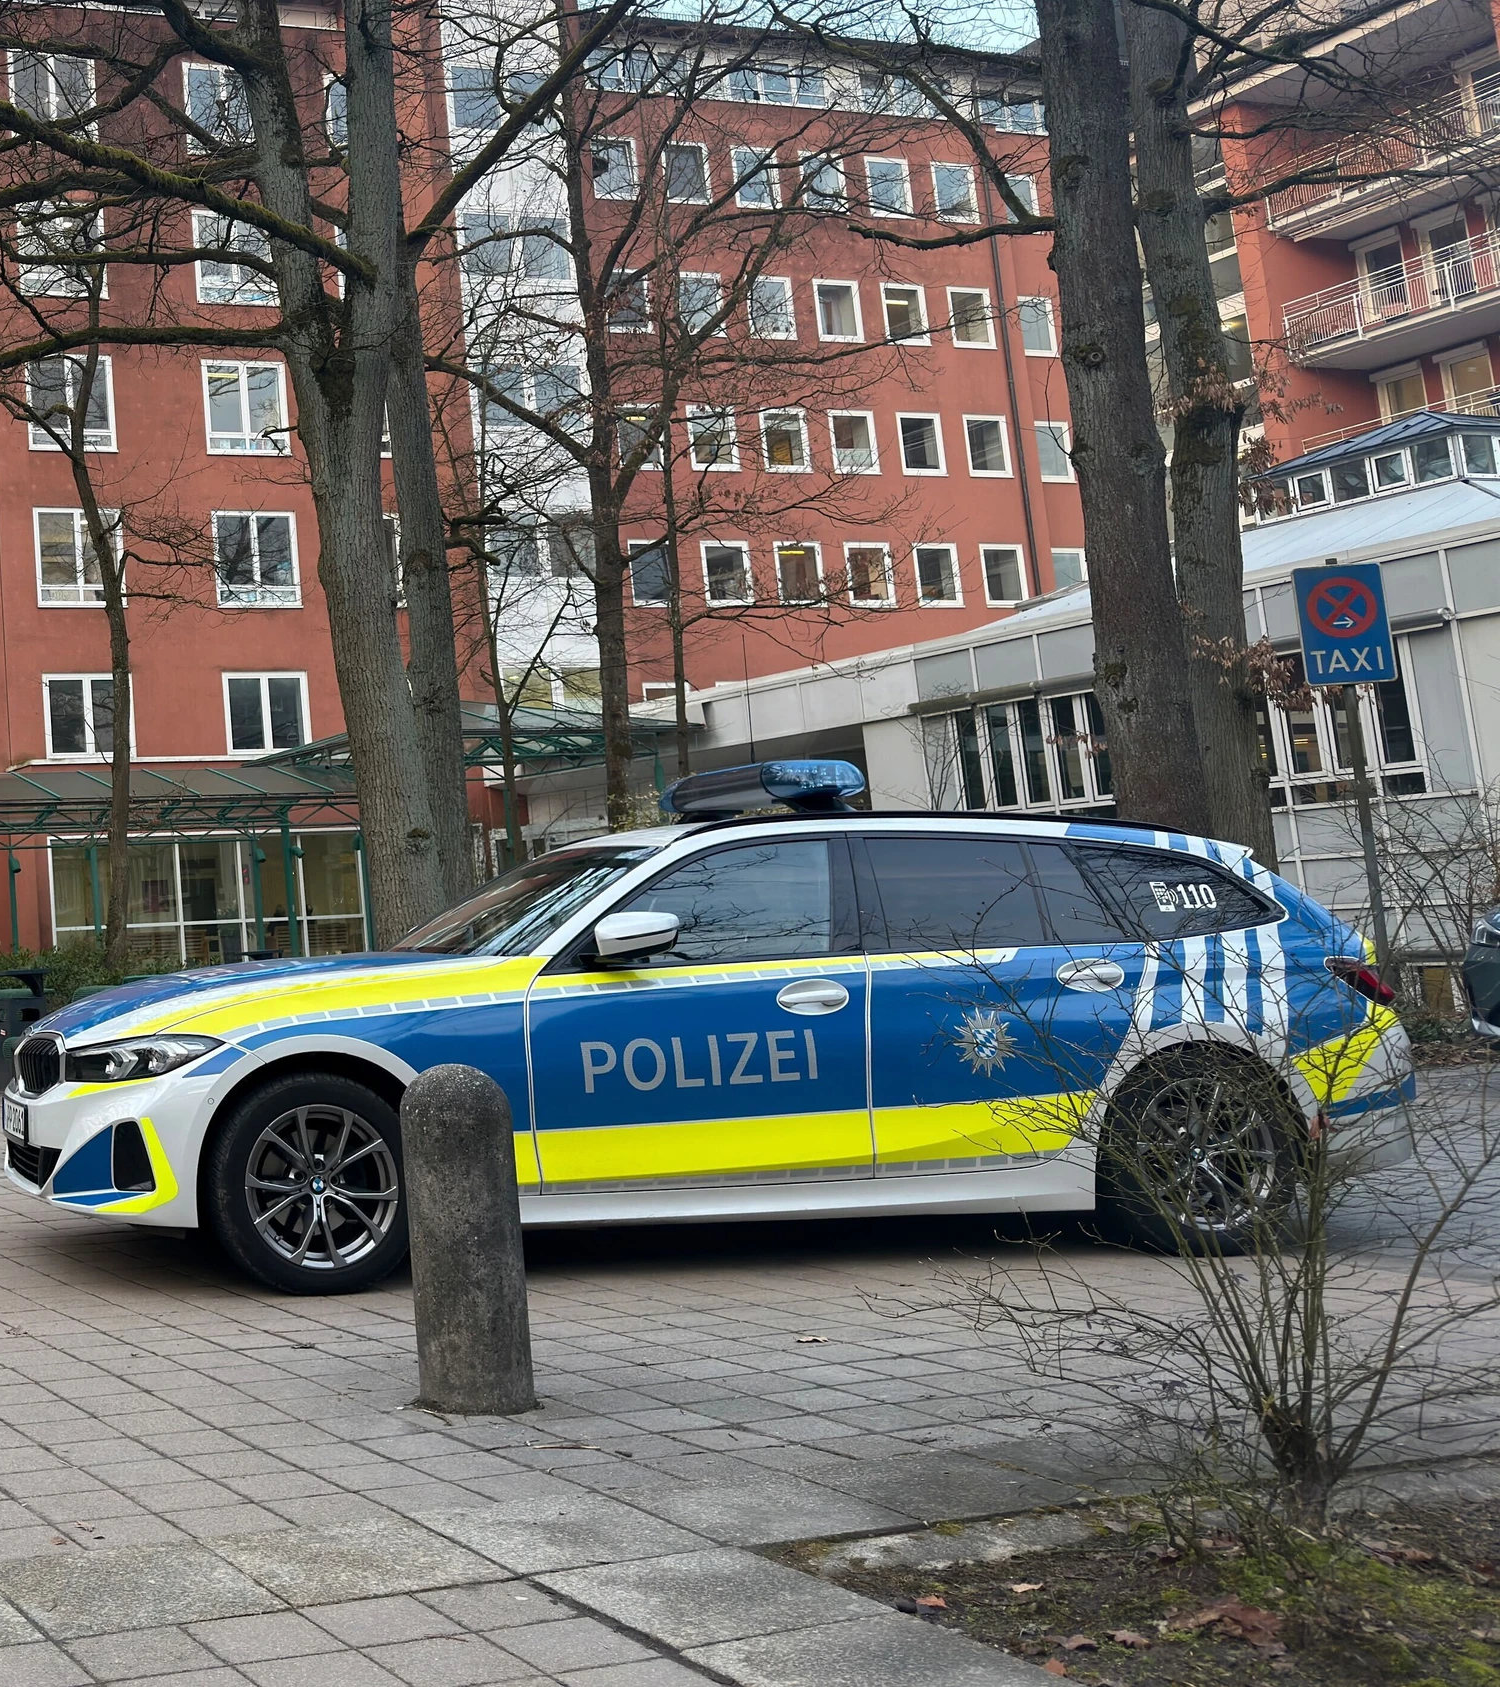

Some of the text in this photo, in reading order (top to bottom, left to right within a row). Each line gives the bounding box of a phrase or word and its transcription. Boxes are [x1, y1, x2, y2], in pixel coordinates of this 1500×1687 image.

[1310, 646, 1385, 675] TAXI
[1176, 883, 1217, 909] 110
[580, 1028, 818, 1094] POLIZEI
